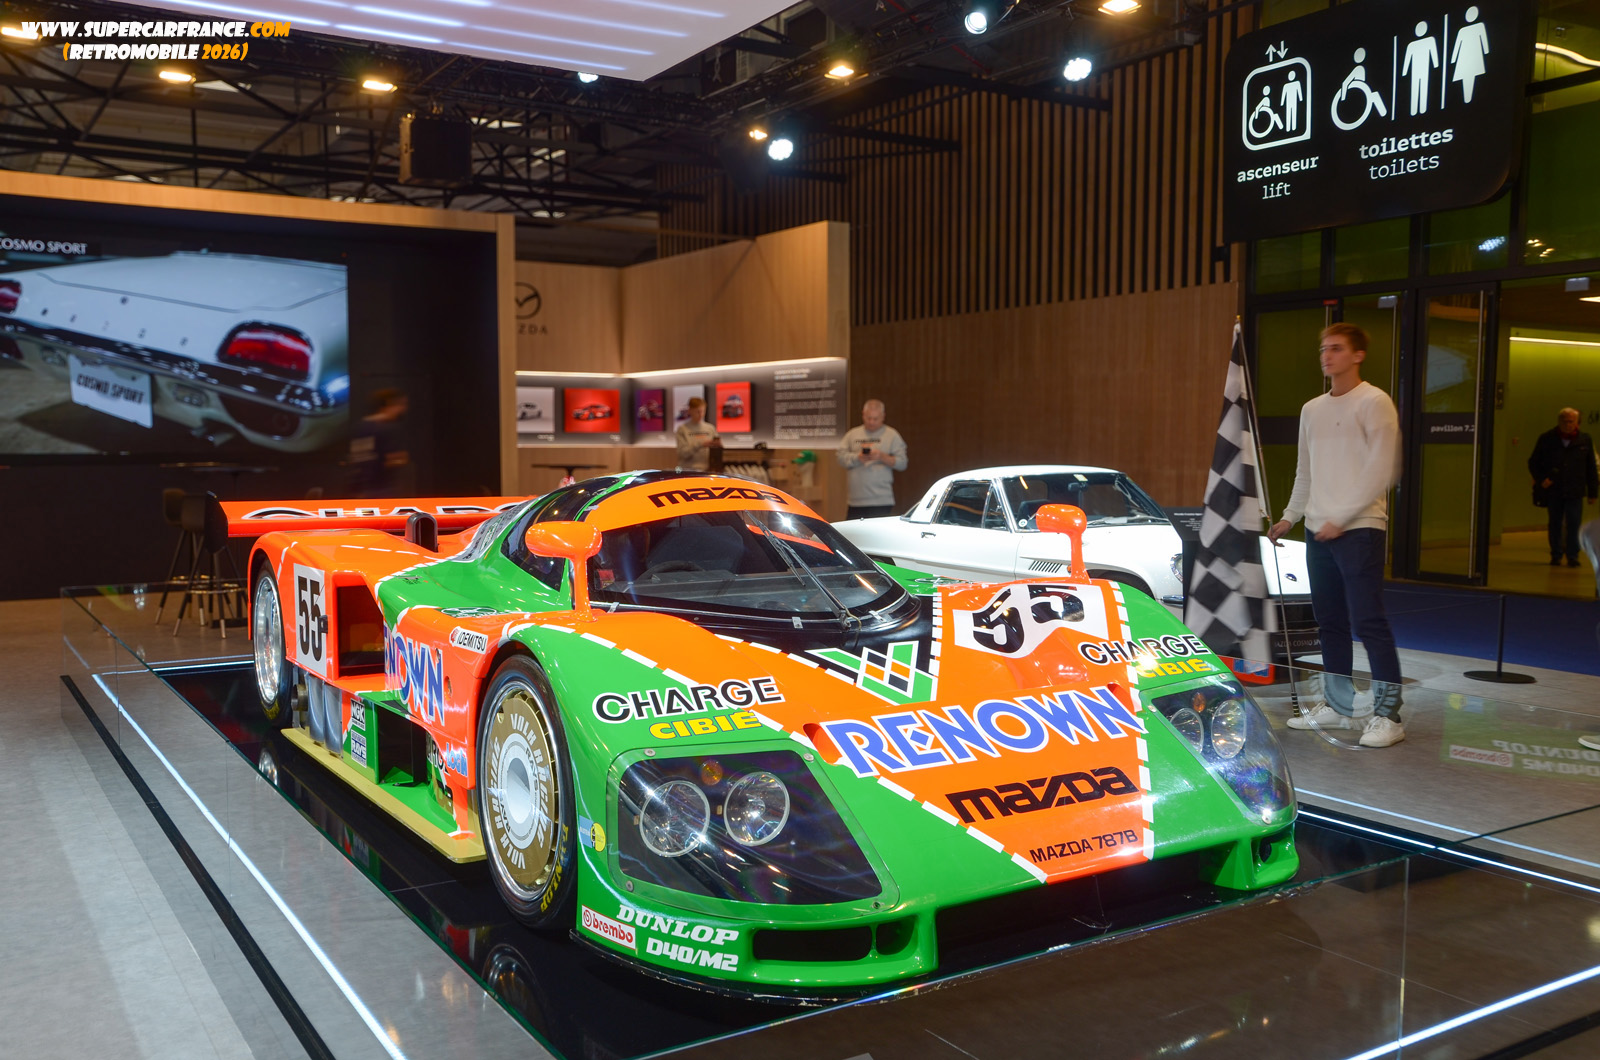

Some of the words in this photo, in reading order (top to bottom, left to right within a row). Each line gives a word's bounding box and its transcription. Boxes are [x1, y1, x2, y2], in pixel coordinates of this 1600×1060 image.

[1359, 128, 1454, 160] toilettes
[1237, 155, 1319, 182] ascenseur
[1369, 155, 1440, 180] toilets
[1262, 182, 1291, 200] lift
[47, 242, 88, 254] SPORT
[77, 374, 110, 396] COSMO
[111, 384, 145, 404] SPORT
[647, 487, 789, 508] mazda
[298, 575, 323, 662] 55
[973, 584, 1085, 654] 55
[457, 632, 488, 651] IDEMITSU
[1079, 635, 1211, 665] CHARGE
[351, 702, 365, 723] NGK
[592, 676, 786, 724] CHARGE
[820, 685, 1149, 779] RENOWN
[945, 766, 1140, 824] mazda
[1029, 839, 1093, 863] MAZDA
[1091, 829, 1138, 849] 787B
[592, 913, 634, 944] brembo
[616, 904, 740, 946] DUNLOP
[646, 937, 739, 972] D40/M2
